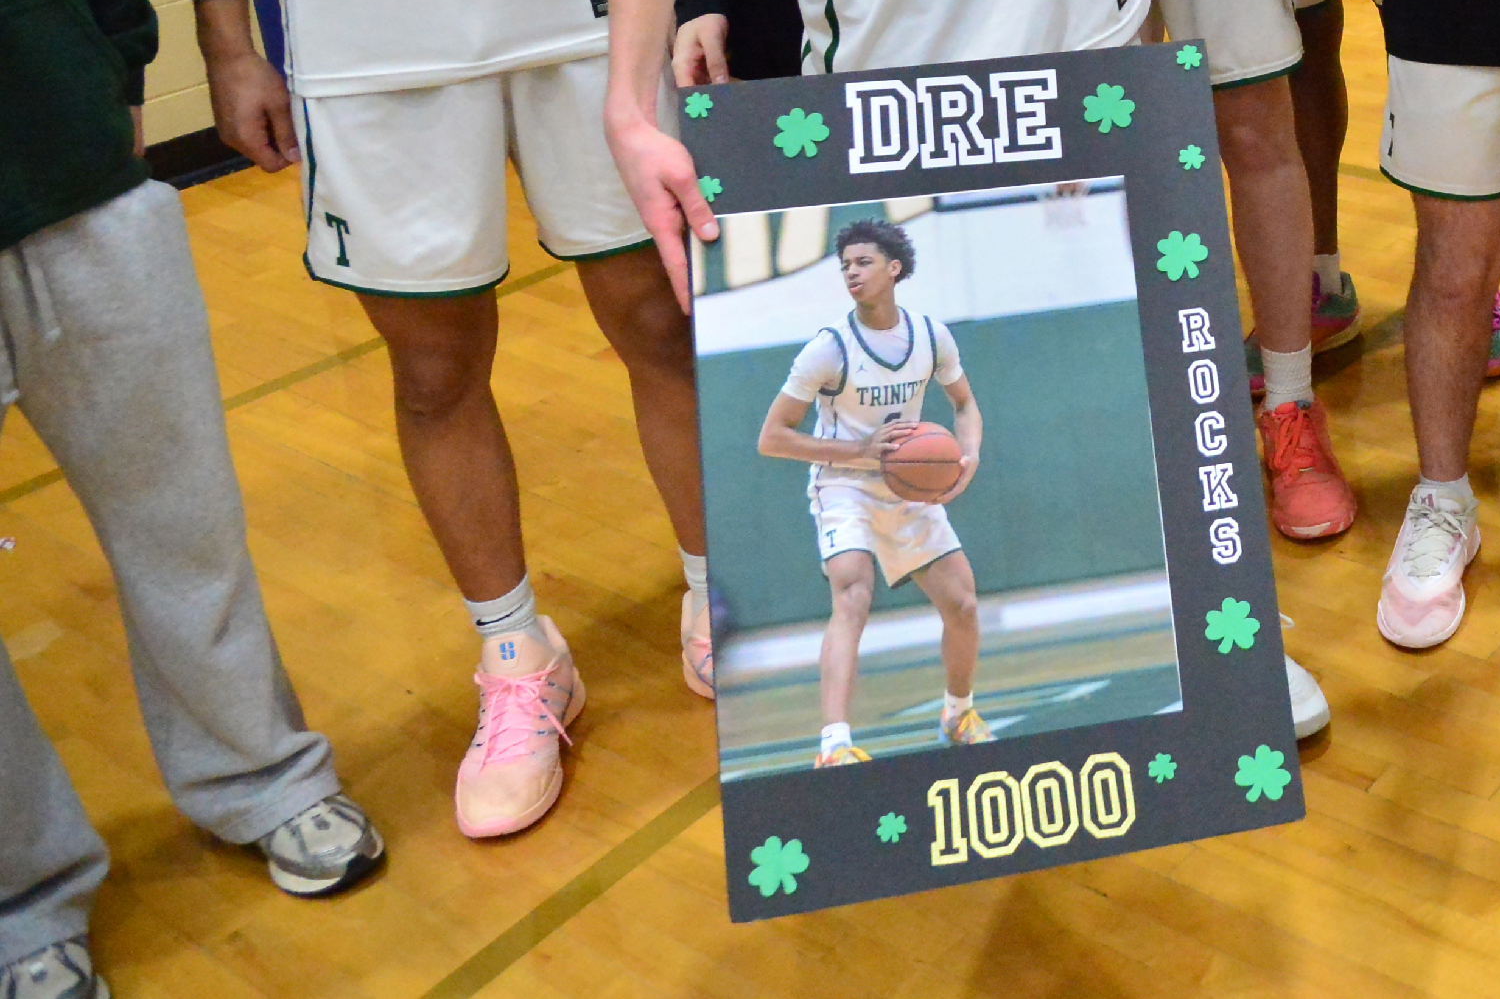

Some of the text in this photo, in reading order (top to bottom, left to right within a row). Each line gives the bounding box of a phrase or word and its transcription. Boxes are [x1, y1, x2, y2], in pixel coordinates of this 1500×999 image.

[845, 69, 1062, 174] DRE
[325, 212, 350, 267] T
[1179, 308, 1242, 564] ROCKS
[928, 752, 1136, 866] 1000
